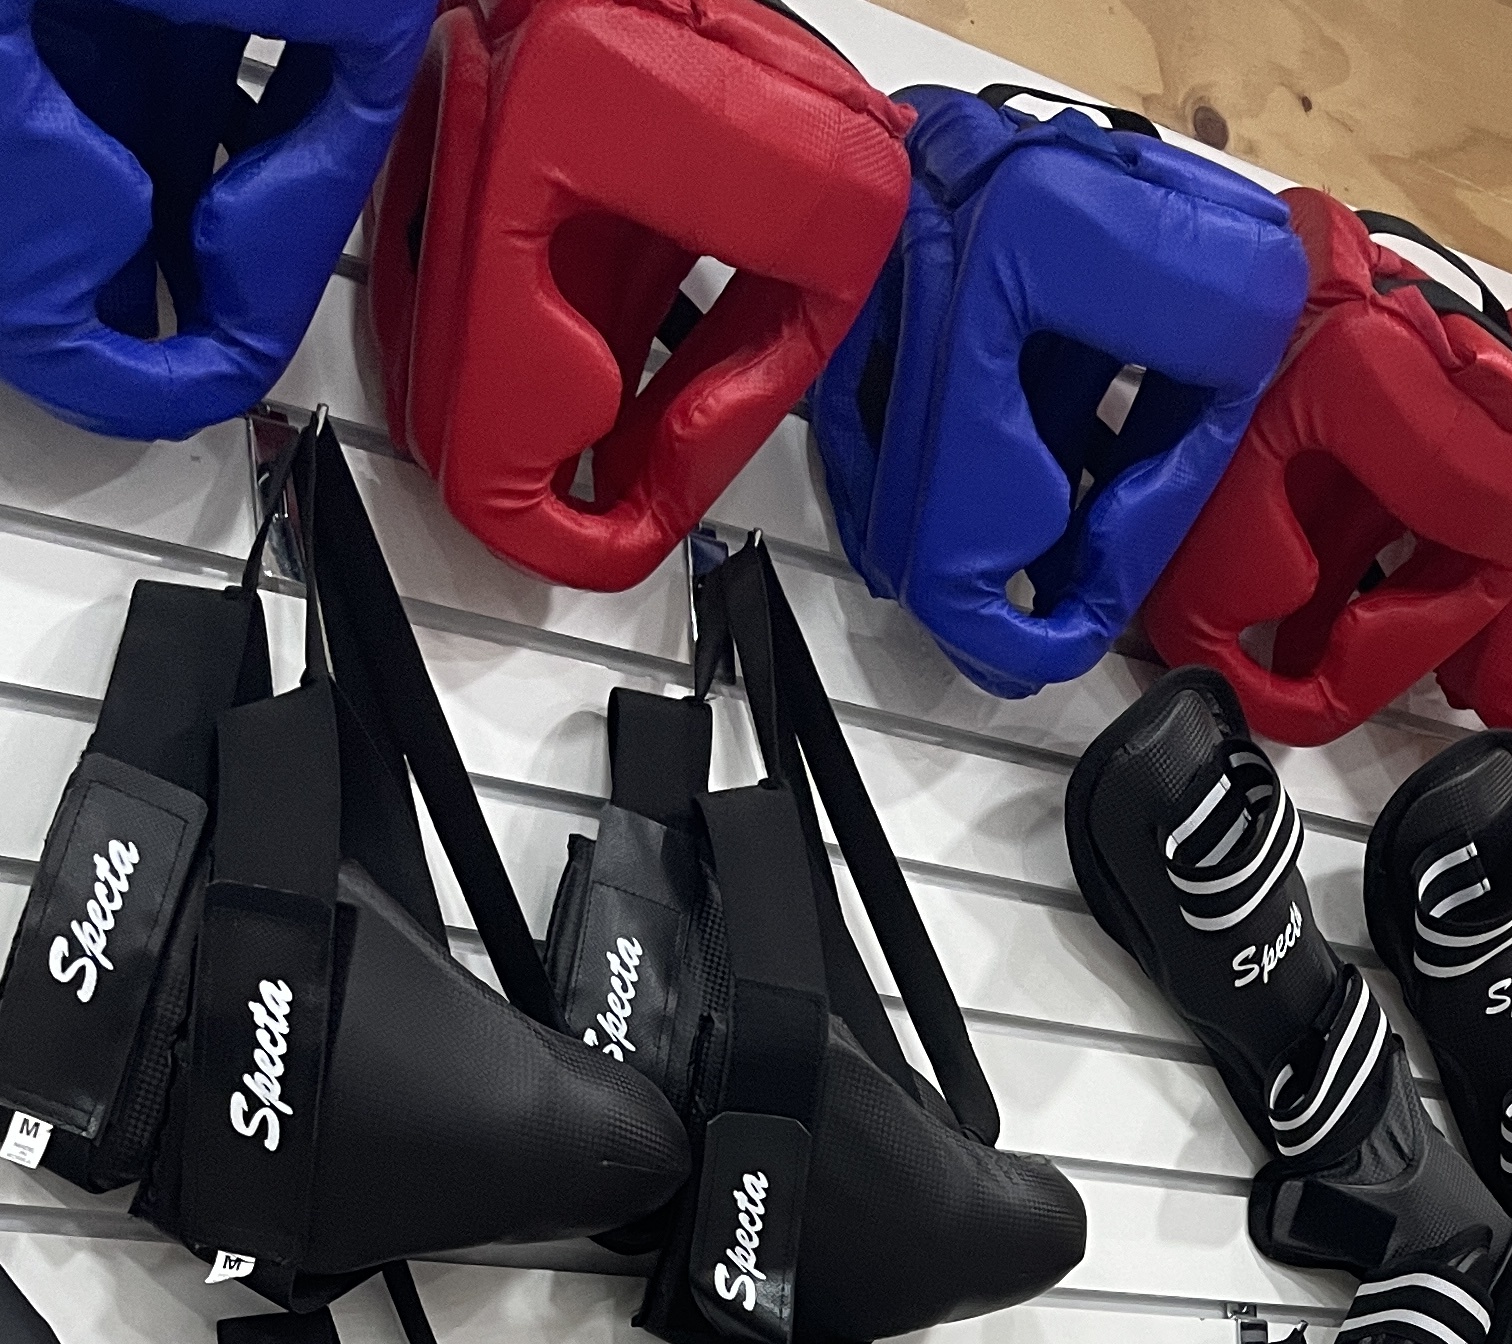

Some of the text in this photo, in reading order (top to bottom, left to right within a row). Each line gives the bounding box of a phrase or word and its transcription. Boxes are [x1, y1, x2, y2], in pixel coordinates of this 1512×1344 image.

[49, 840, 140, 1003] Specta
[1232, 901, 1303, 987] Spect
[19, 1117, 41, 1138] M
[230, 979, 293, 1152] Specta
[714, 1171, 770, 1311] Specta
